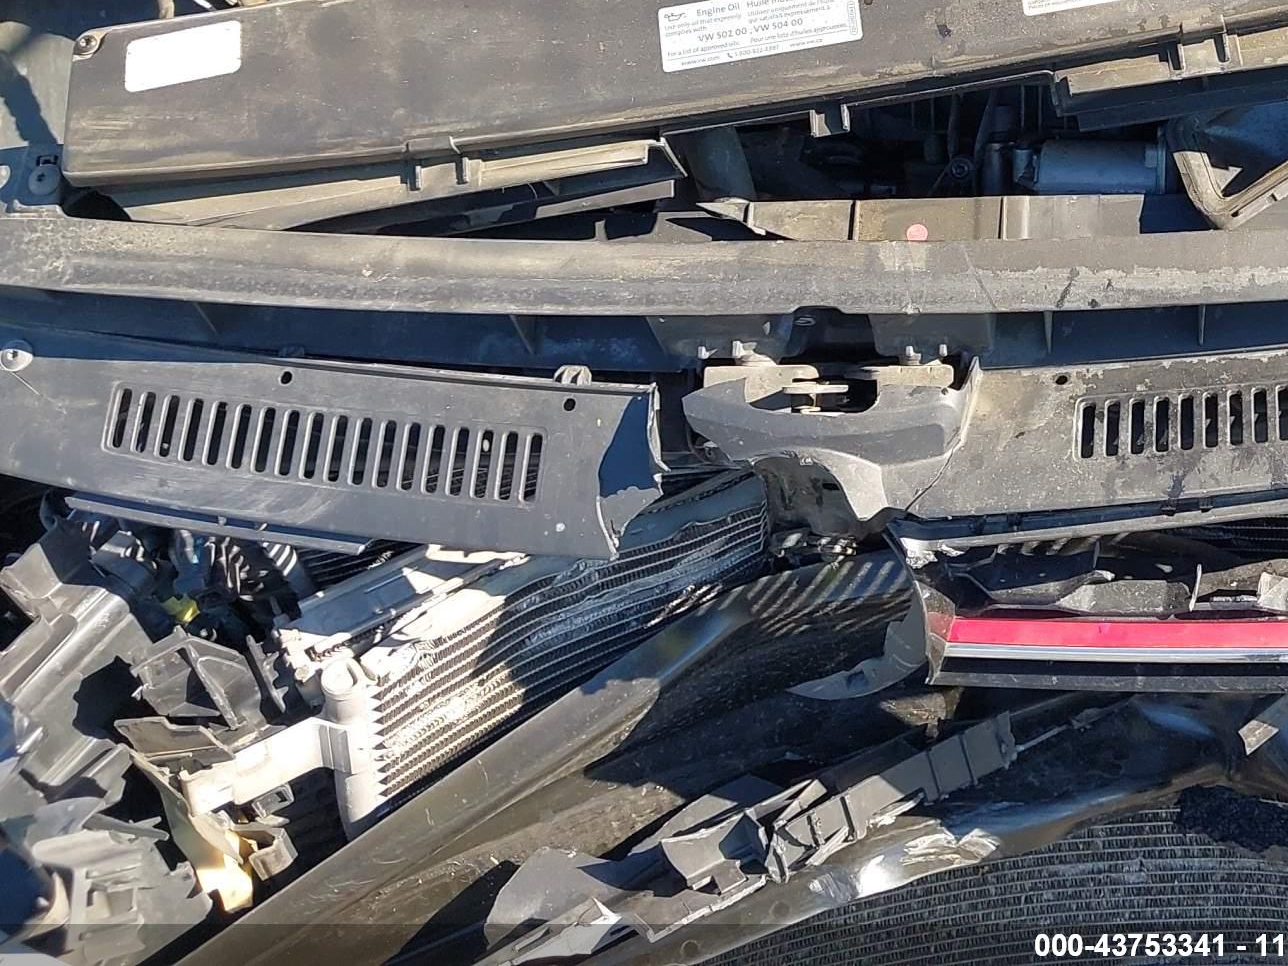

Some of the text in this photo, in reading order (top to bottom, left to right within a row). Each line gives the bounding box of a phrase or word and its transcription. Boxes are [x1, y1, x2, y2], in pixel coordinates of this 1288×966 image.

[697, 2, 740, 18] Engine Oil
[698, 33, 714, 42] VW
[717, 30, 733, 39] 502
[735, 27, 747, 36] 00
[754, 23, 769, 32] VW
[772, 20, 788, 29] 504
[791, 18, 803, 26] 00
